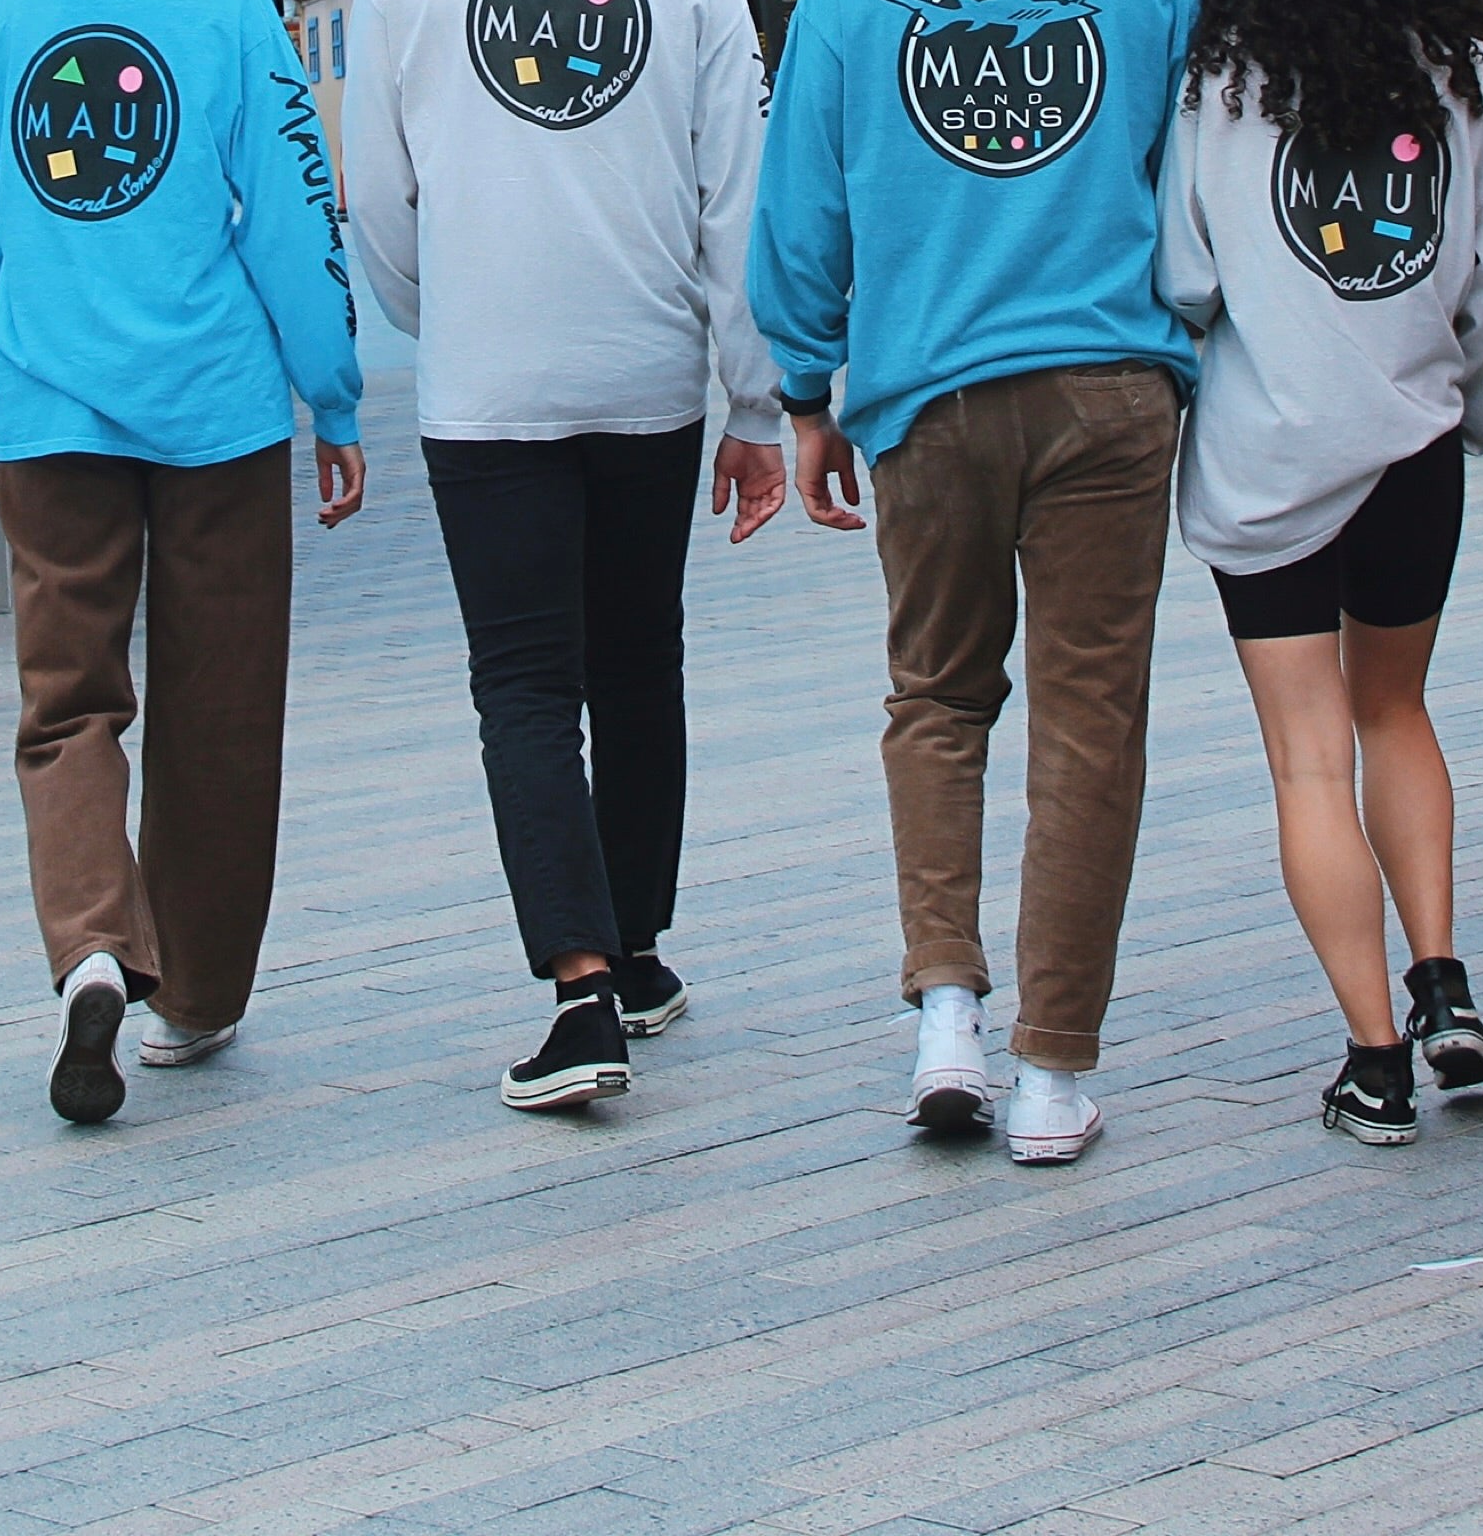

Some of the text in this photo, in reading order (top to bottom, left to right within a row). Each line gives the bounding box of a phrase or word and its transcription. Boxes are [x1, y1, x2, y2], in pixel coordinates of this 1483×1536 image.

[482, 4, 635, 55] MAUI
[919, 45, 1085, 88] MAUI
[533, 97, 574, 122] and
[963, 93, 1043, 105] AND
[25, 101, 163, 141] MAUI
[942, 107, 1063, 130] SONS
[67, 186, 114, 214] and
[1288, 167, 1437, 215] MAUI
[1335, 265, 1383, 292] and
